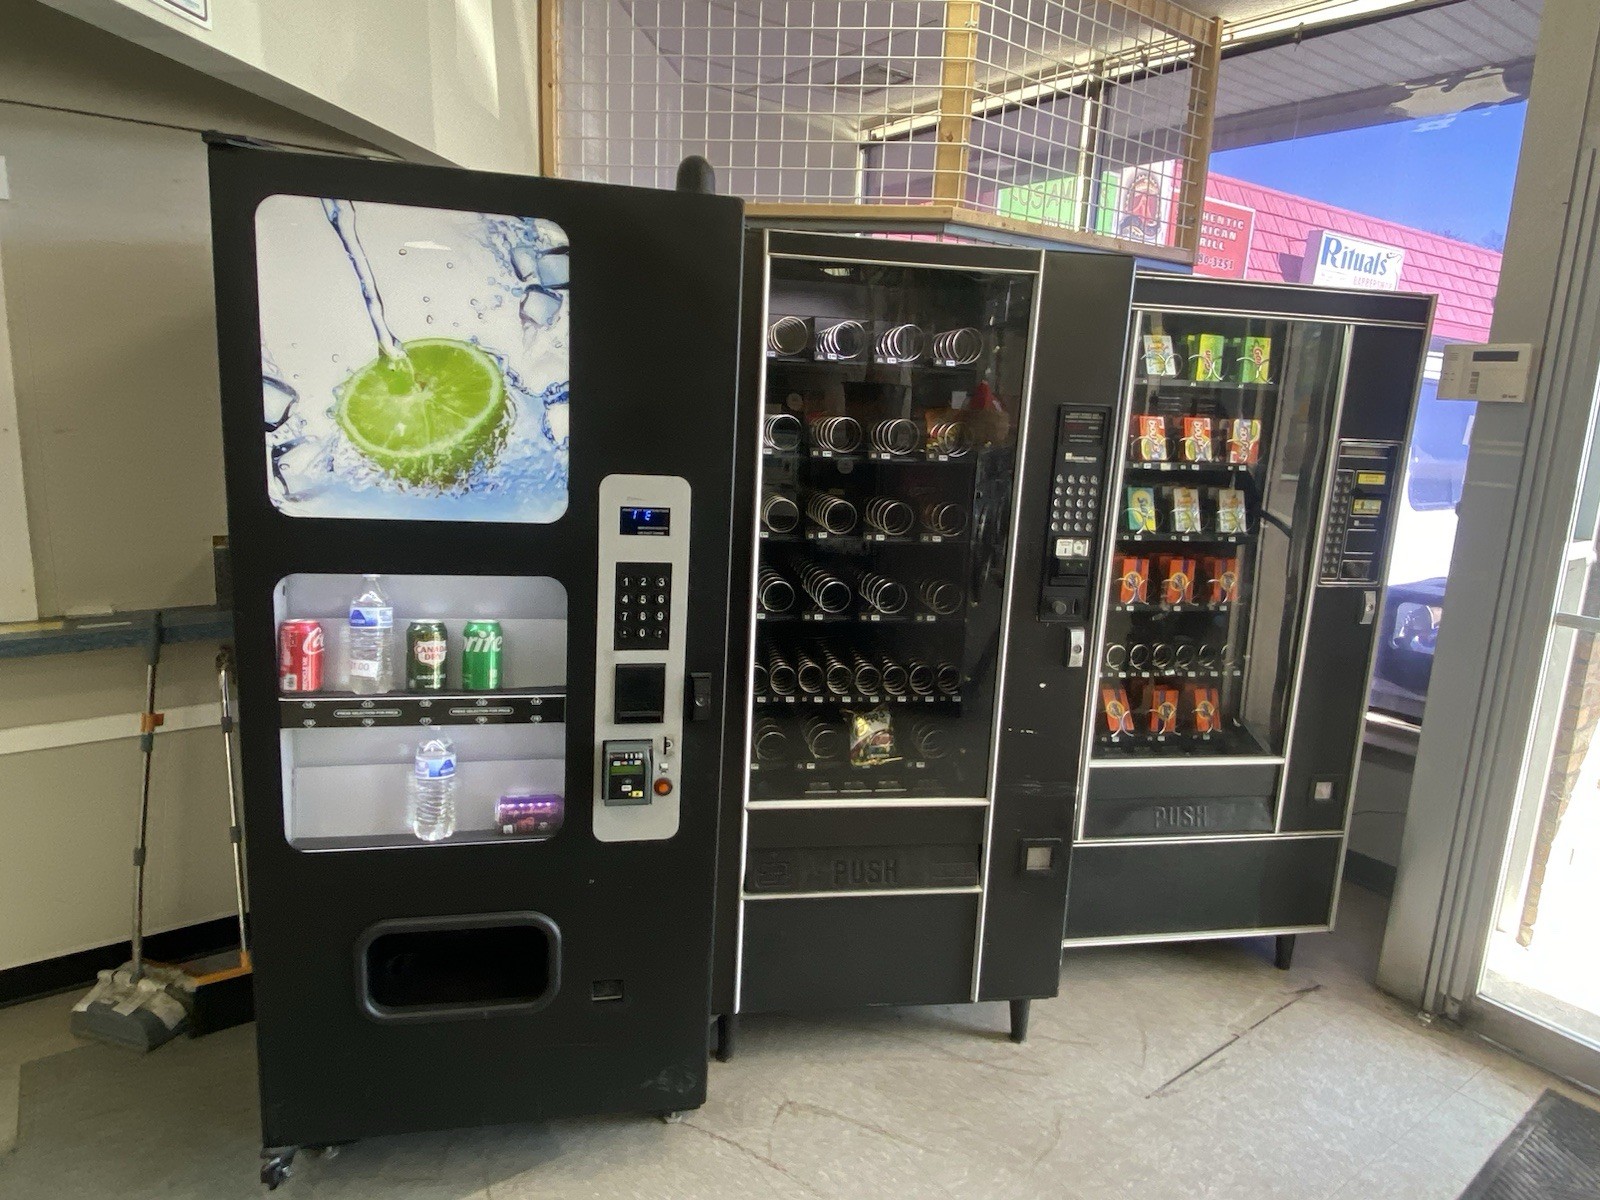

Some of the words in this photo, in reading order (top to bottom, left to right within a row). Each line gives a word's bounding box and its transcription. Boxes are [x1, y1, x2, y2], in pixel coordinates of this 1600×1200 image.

[1202, 211, 1245, 231] HENTIC
[1199, 237, 1225, 252] RILL
[1320, 236, 1389, 276] Rituals
[641, 578, 647, 586] 2
[658, 578, 665, 586] 3
[622, 595, 629, 604] 4
[640, 595, 647, 604] 5
[658, 595, 664, 604] 6
[622, 612, 629, 621] 7
[640, 612, 646, 620] 8
[657, 612, 664, 621] 9
[639, 628, 646, 637] 0
[1155, 805, 1210, 828] PUSH
[832, 858, 898, 885] PUSH
